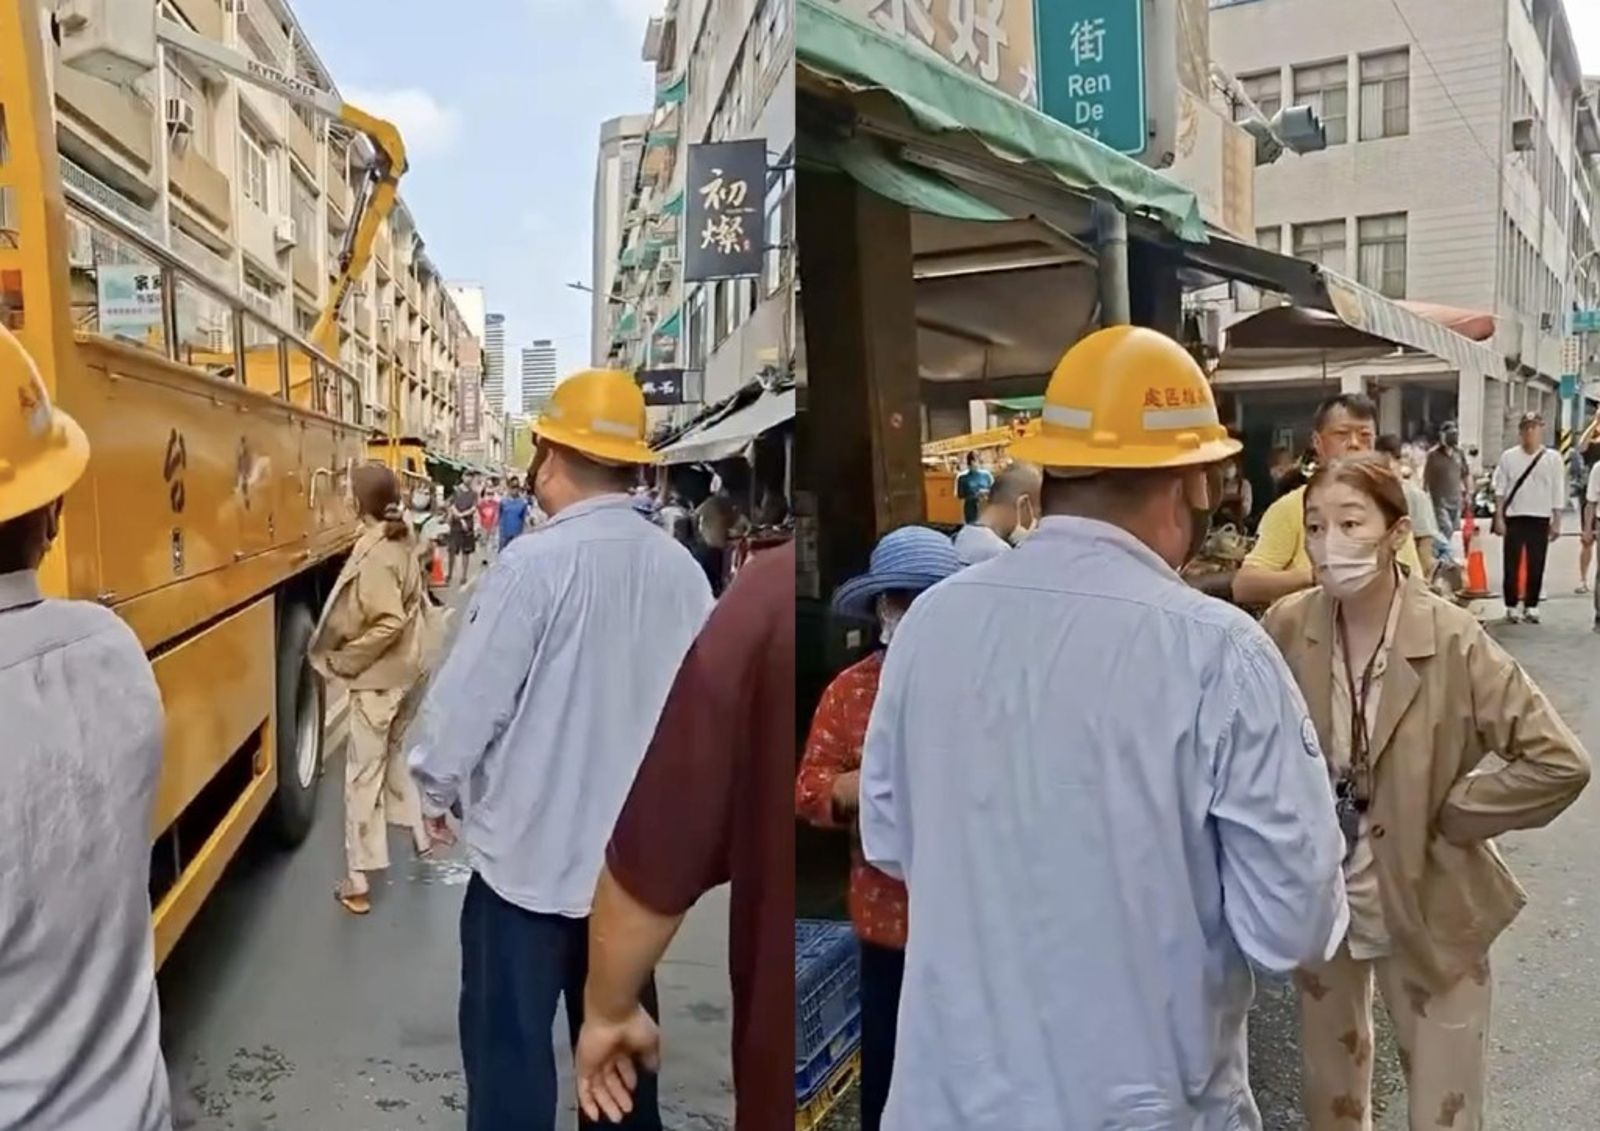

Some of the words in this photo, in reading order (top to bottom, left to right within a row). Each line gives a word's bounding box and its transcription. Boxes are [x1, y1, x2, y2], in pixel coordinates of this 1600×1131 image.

[1070, 18, 1106, 67] 街
[1068, 73, 1111, 98] Ren
[1075, 101, 1104, 124] De
